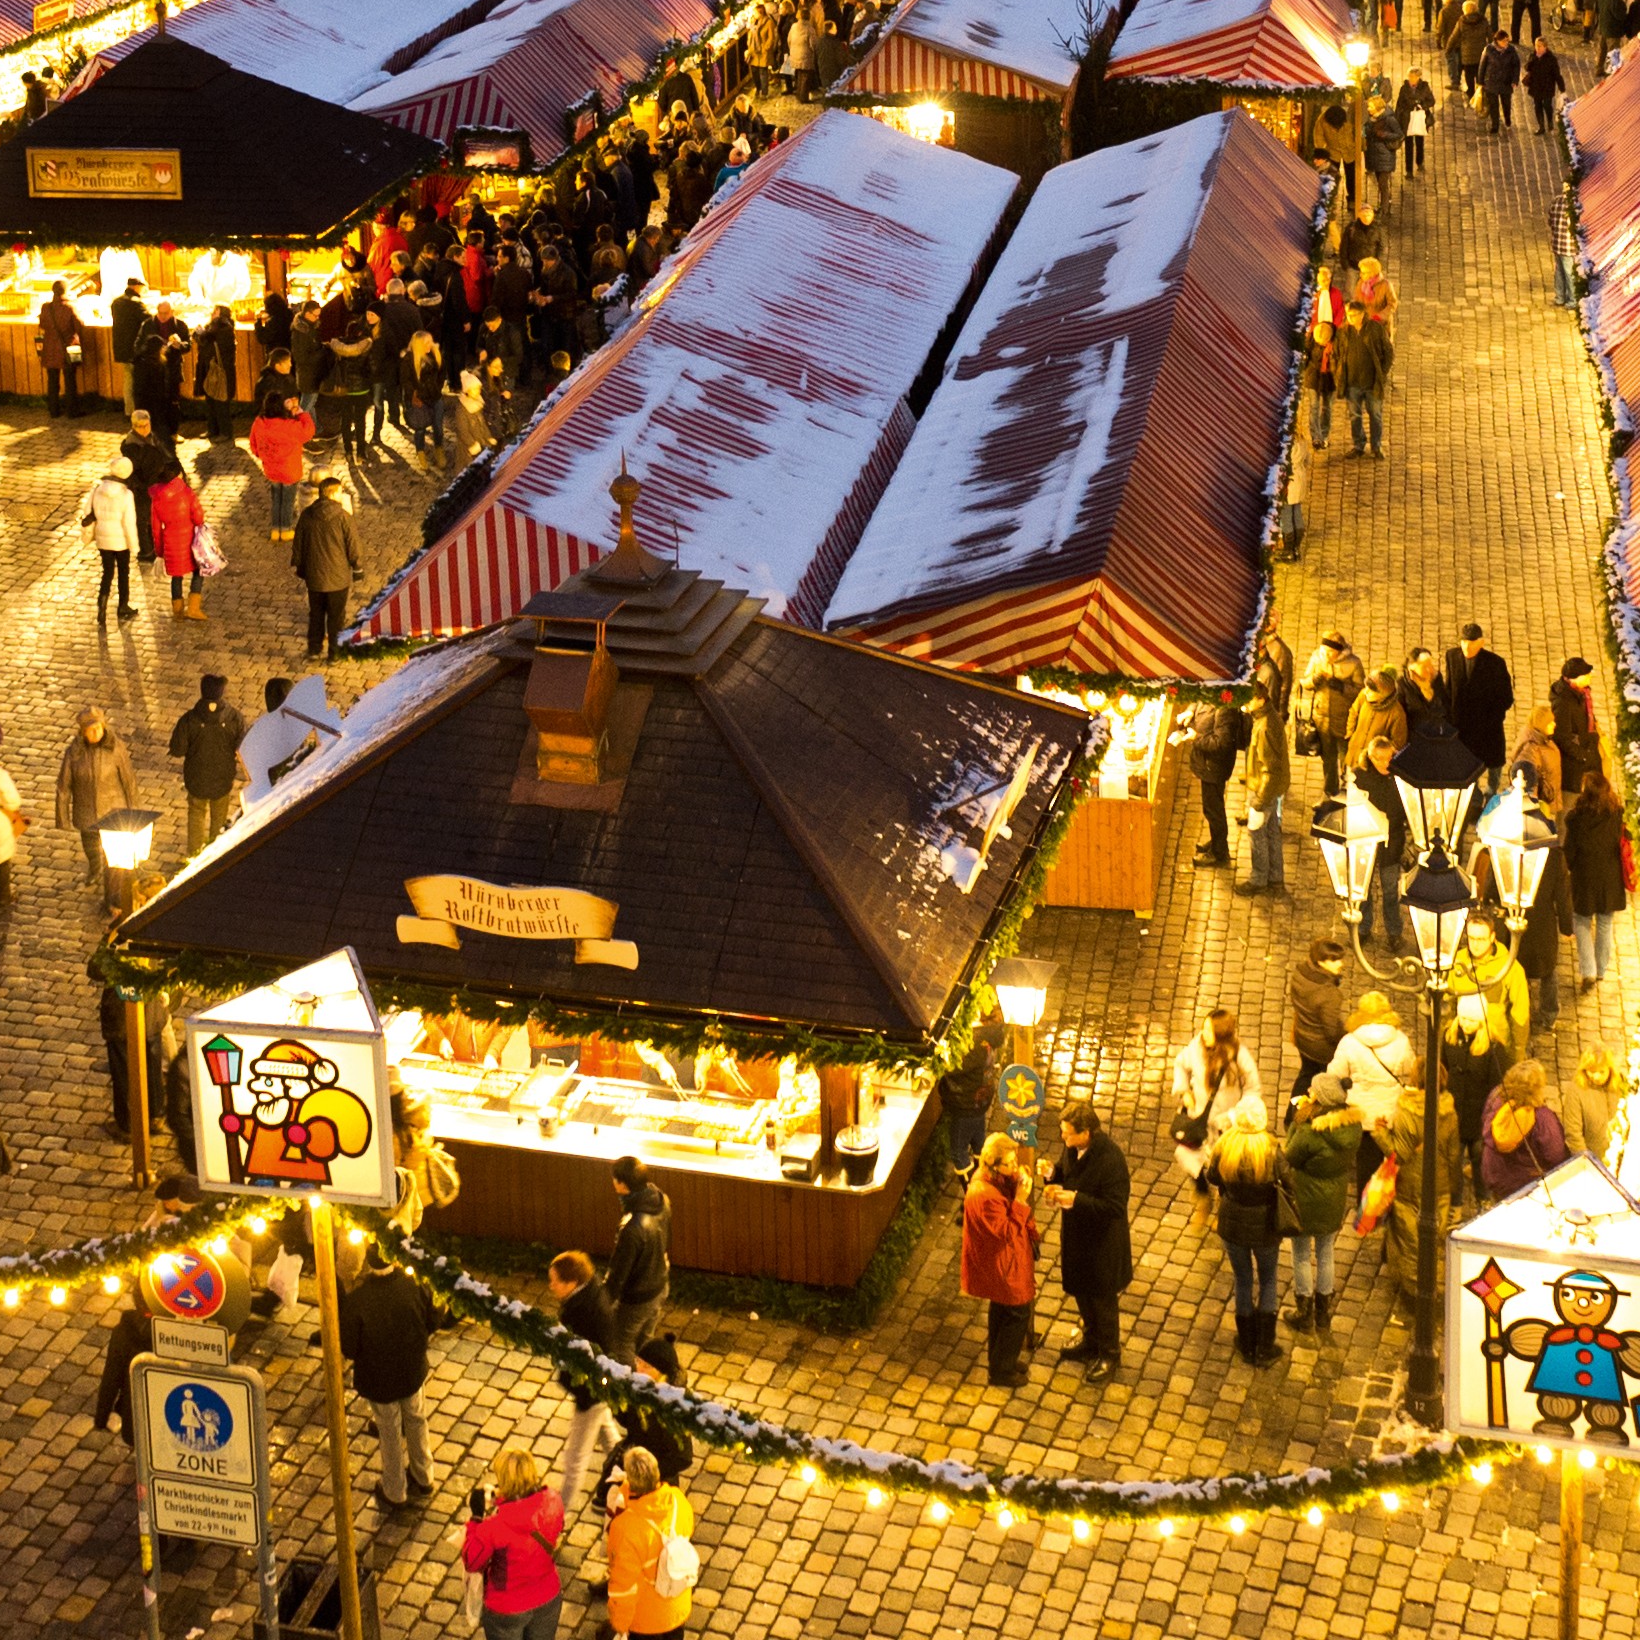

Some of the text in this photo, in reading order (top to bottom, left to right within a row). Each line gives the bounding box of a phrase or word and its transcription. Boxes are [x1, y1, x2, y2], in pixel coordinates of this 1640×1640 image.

[459, 880, 561, 913] Nürnberger
[1011, 1129, 1029, 1141] WC
[159, 1332, 223, 1355] Rettungsweg
[176, 1453, 229, 1476] ZONE
[157, 1485, 252, 1510] Marktbeschicker zum
[164, 1500, 247, 1523] Christkindlesmarkt
[174, 1519, 190, 1529] von
[221, 1525, 237, 1536] frei
